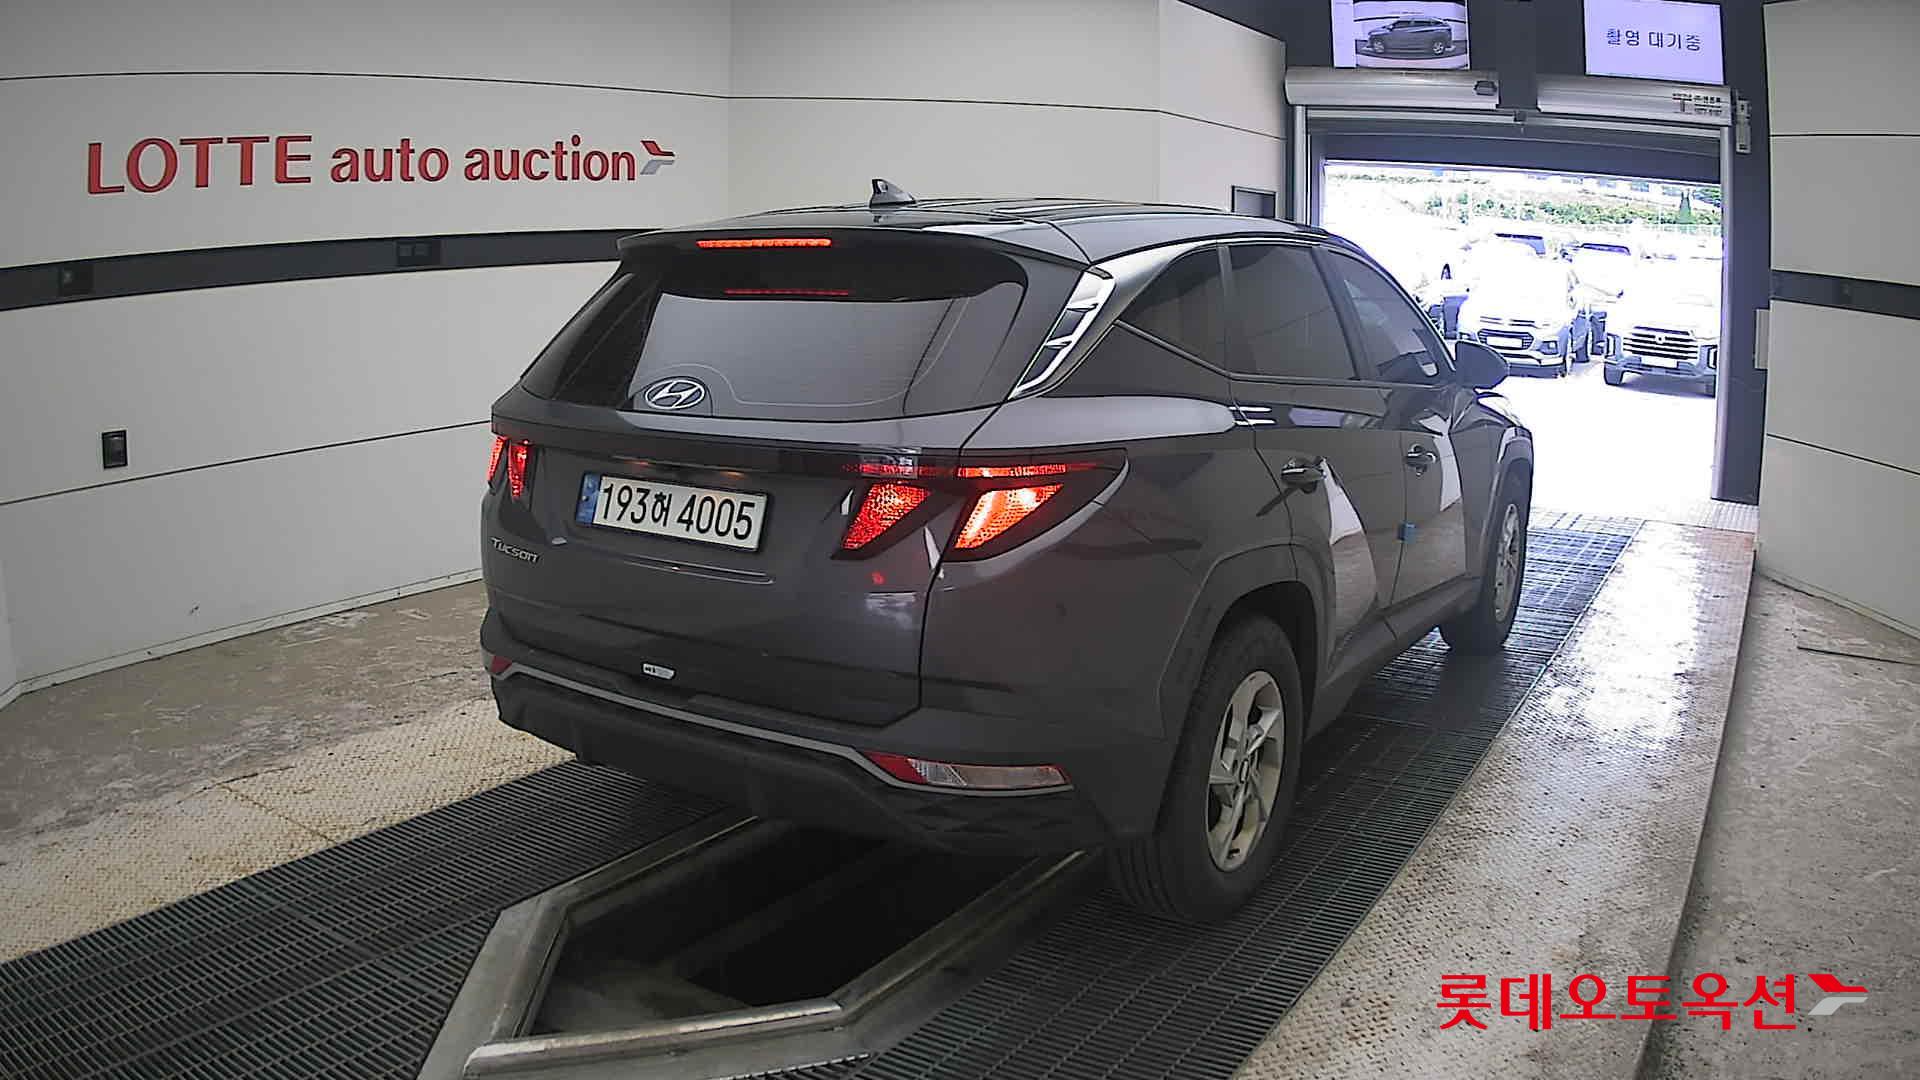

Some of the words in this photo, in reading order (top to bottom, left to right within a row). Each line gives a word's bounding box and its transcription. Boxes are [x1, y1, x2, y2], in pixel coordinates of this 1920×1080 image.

[1648, 32, 1701, 52] 대기중
[88, 135, 312, 194] LOTTE
[330, 138, 449, 182] auto
[464, 135, 636, 182] auction
[603, 483, 673, 527] 193허
[677, 494, 756, 540] 4005
